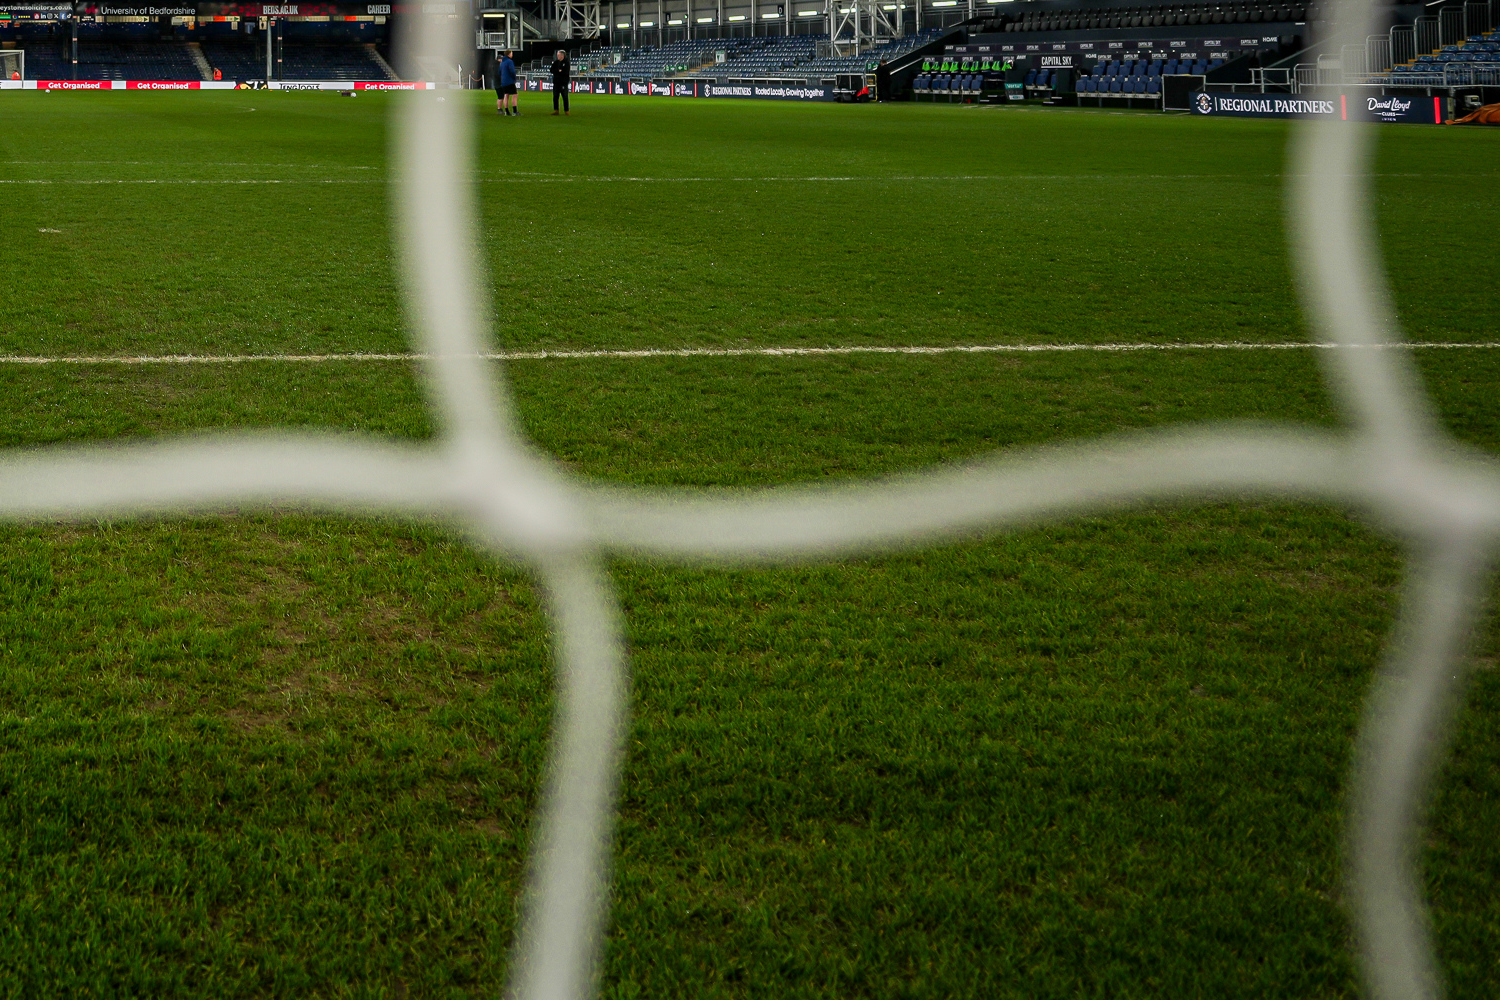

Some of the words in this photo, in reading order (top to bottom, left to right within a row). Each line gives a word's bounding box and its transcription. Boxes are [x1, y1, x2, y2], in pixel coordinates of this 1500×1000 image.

[101, 7, 138, 16] University
[139, 7, 148, 15] of
[150, 7, 196, 15] Bedfordshire
[263, 6, 298, 15] BEDS.AC.UK
[367, 5, 390, 14] CAREER
[1041, 56, 1061, 66] CAPITAL
[1062, 56, 1072, 65] SKY
[63, 82, 100, 90] Organised
[152, 82, 189, 90] Organised
[713, 87, 732, 95] REGIONAL
[733, 87, 752, 96] PARTNERS
[755, 87, 770, 95] Rooted
[786, 88, 804, 98] Growing
[804, 89, 824, 98] Together
[1220, 99, 1274, 113] REGIONAL
[1274, 100, 1335, 114] PARTNERS
[1367, 97, 1391, 111] David
[1391, 98, 1411, 112] Lloyd
